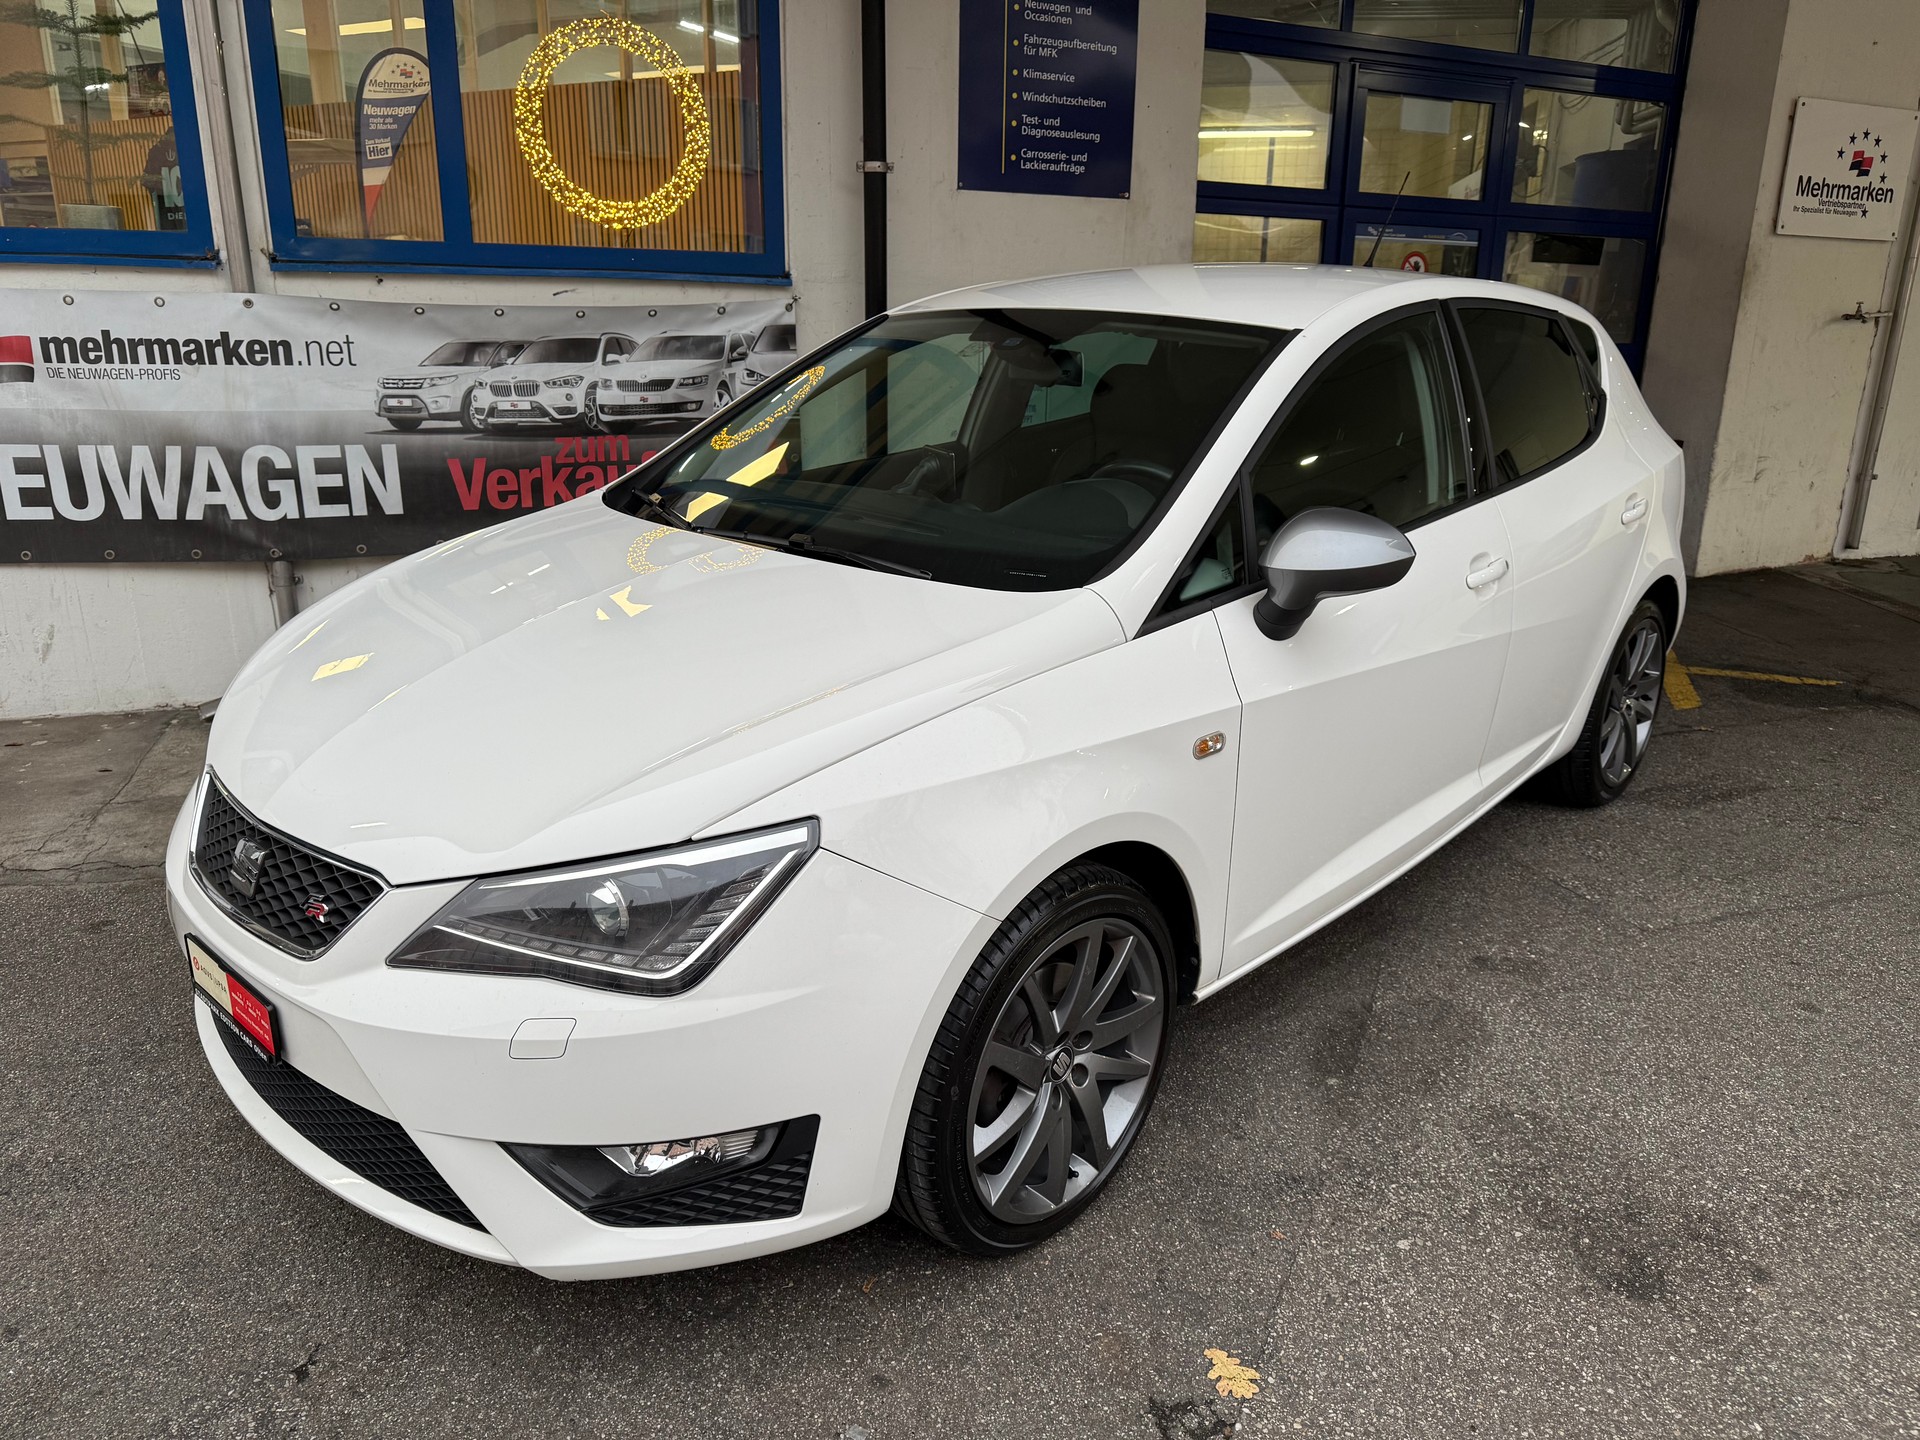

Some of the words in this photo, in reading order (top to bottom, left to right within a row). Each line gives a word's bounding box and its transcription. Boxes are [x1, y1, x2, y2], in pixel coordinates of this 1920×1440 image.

[1024, 0, 1071, 13] Neuwagen
[1075, 6, 1092, 16] und
[1024, 10, 1073, 25] Occasionen
[1023, 33, 1118, 56] Fahrzeugaufbereitung
[1023, 45, 1037, 56] für
[1038, 47, 1058, 58] MFK
[1022, 68, 1076, 83] Klimaservice
[368, 79, 430, 89] Mehrmarken
[1022, 91, 1107, 108] Windschutzscheiben
[363, 104, 416, 117] Neuwagen
[1021, 114, 1042, 125] Test-
[1043, 117, 1060, 126] und
[1021, 125, 1101, 143] Diagnoseauslesung
[367, 145, 390, 158] Hier
[1020, 148, 1069, 161] Carrosserie-
[1071, 152, 1088, 162] und
[1020, 160, 1086, 175] Lackieraufträge
[1795, 175, 1894, 204] Mehrmarken
[1800, 205, 1824, 215] Spezialist
[1832, 208, 1858, 217] Neuwagen
[1817, 198, 1866, 210] Vertriebspartner
[39, 329, 357, 367] mehrmarken.net
[46, 367, 67, 379] DIE
[67, 367, 181, 381] NEUWAGEN-PROFIS
[554, 434, 630, 464] zum
